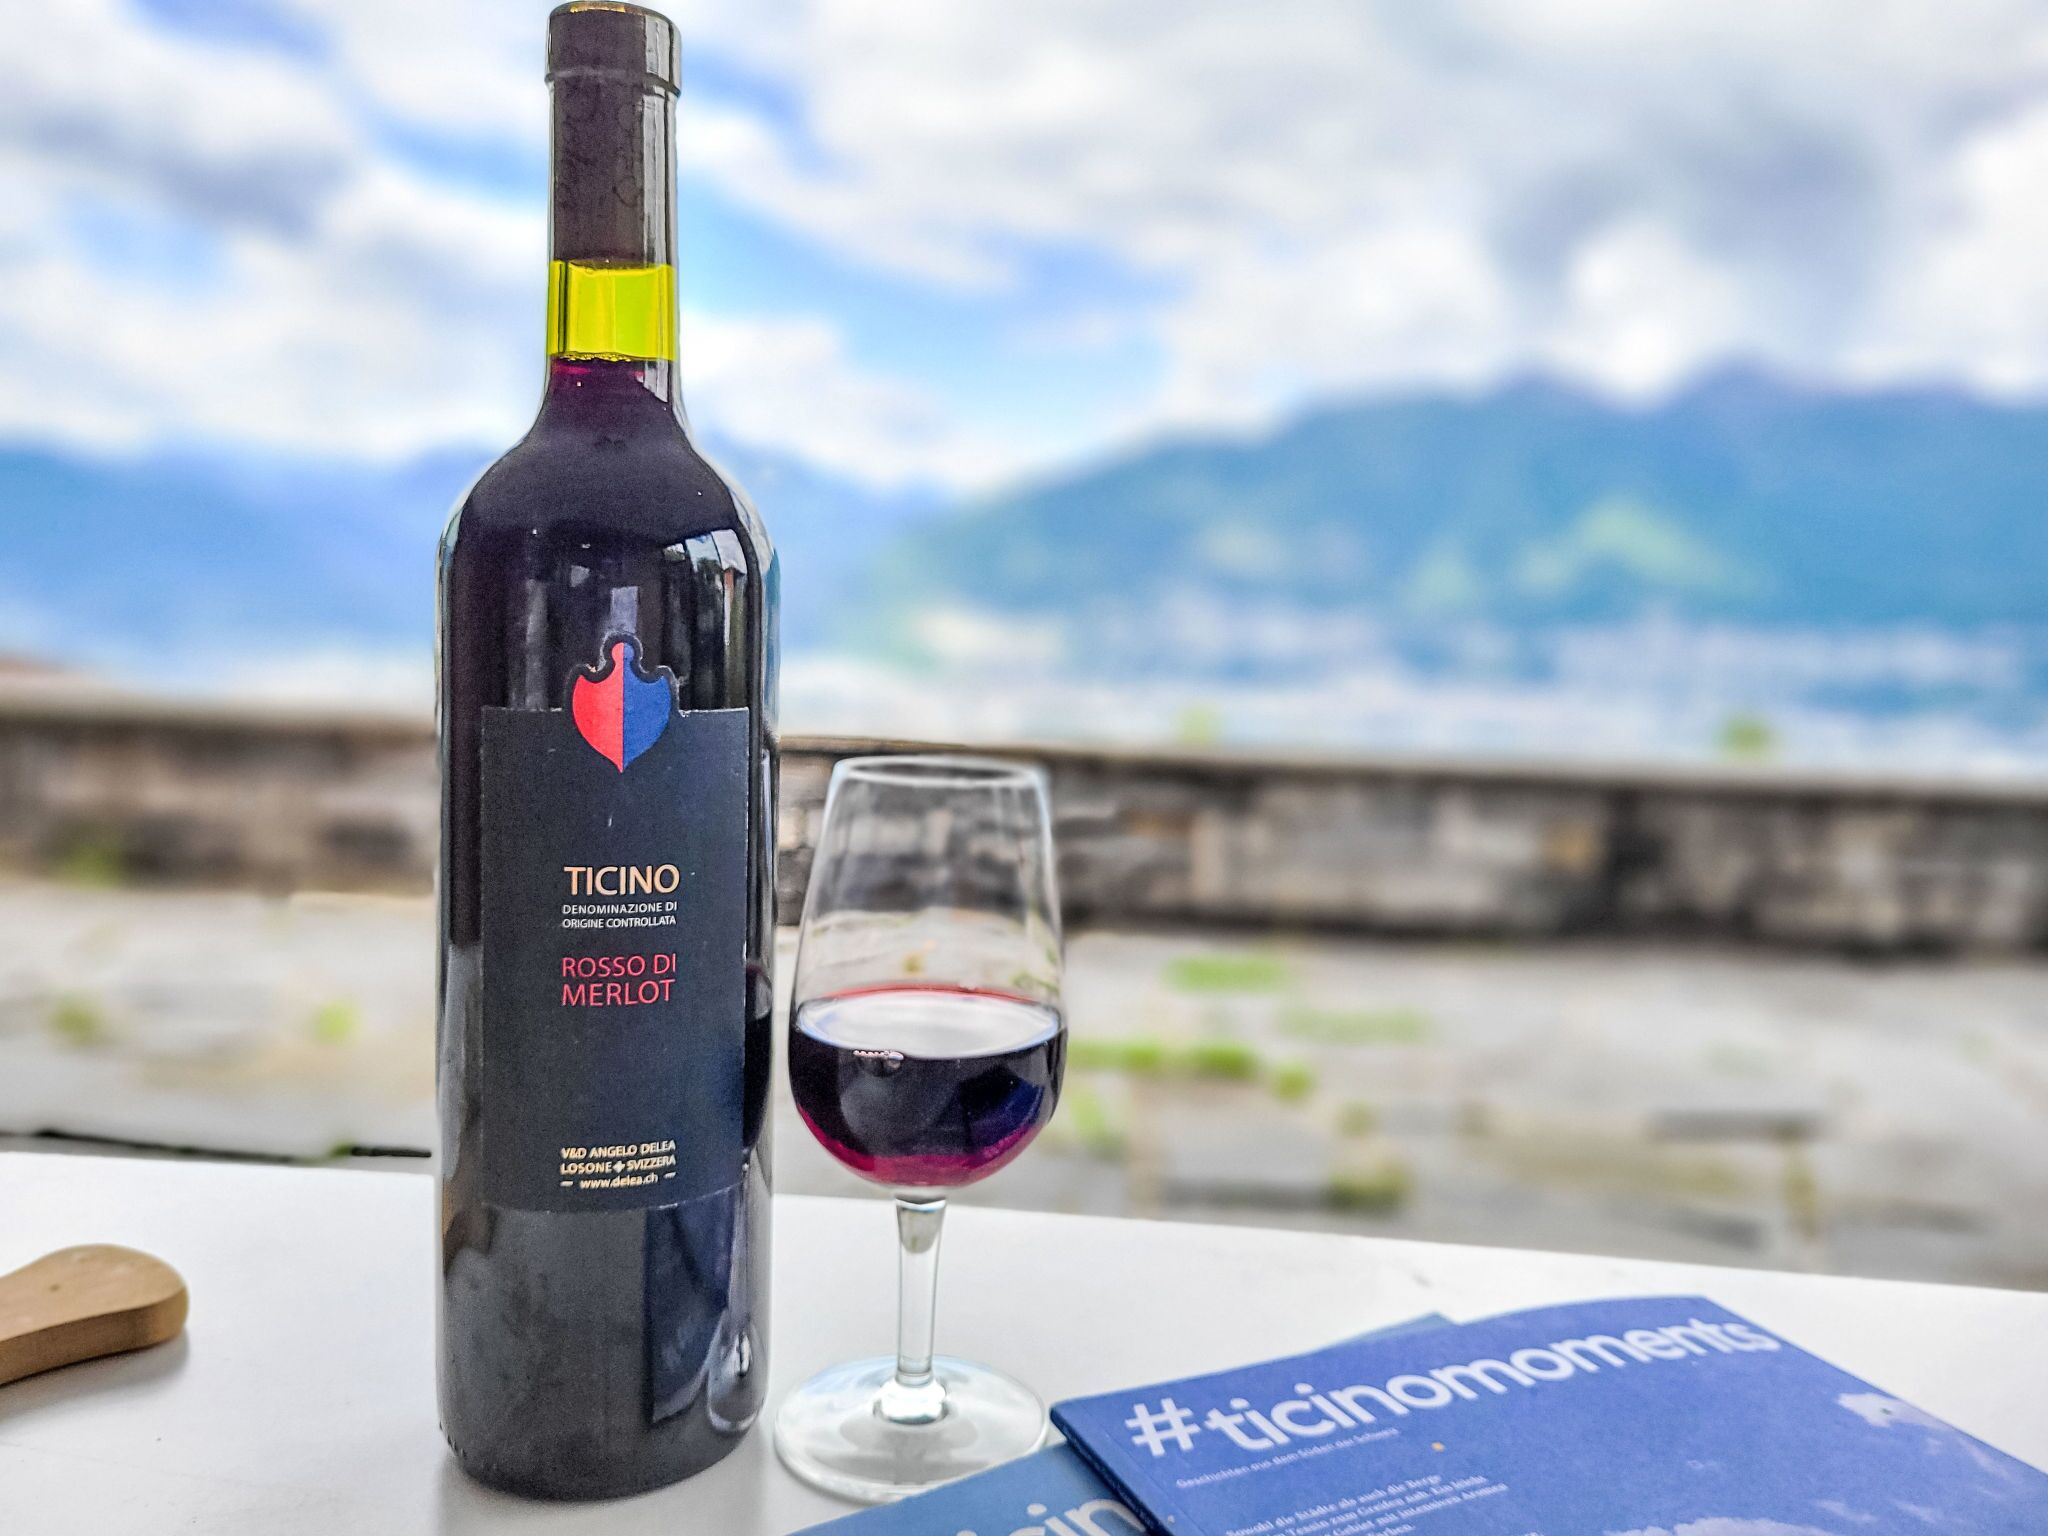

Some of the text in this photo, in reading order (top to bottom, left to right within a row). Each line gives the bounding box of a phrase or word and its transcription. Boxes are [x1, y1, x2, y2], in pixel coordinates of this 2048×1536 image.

[564, 864, 680, 895] TICINO
[562, 901, 678, 915] DENOMINAZIONE DI
[562, 915, 676, 928] ORIGINE CONTROLLATA
[562, 953, 676, 978] ROSSO DI
[562, 979, 676, 1007] MERLOT
[561, 1140, 676, 1160] V&D ANGELO DELEA
[560, 1154, 676, 1175] LOSONE SVIZZERA
[580, 1172, 659, 1189] www.delea.ch
[1124, 1317, 1781, 1457] #ticinomoments
